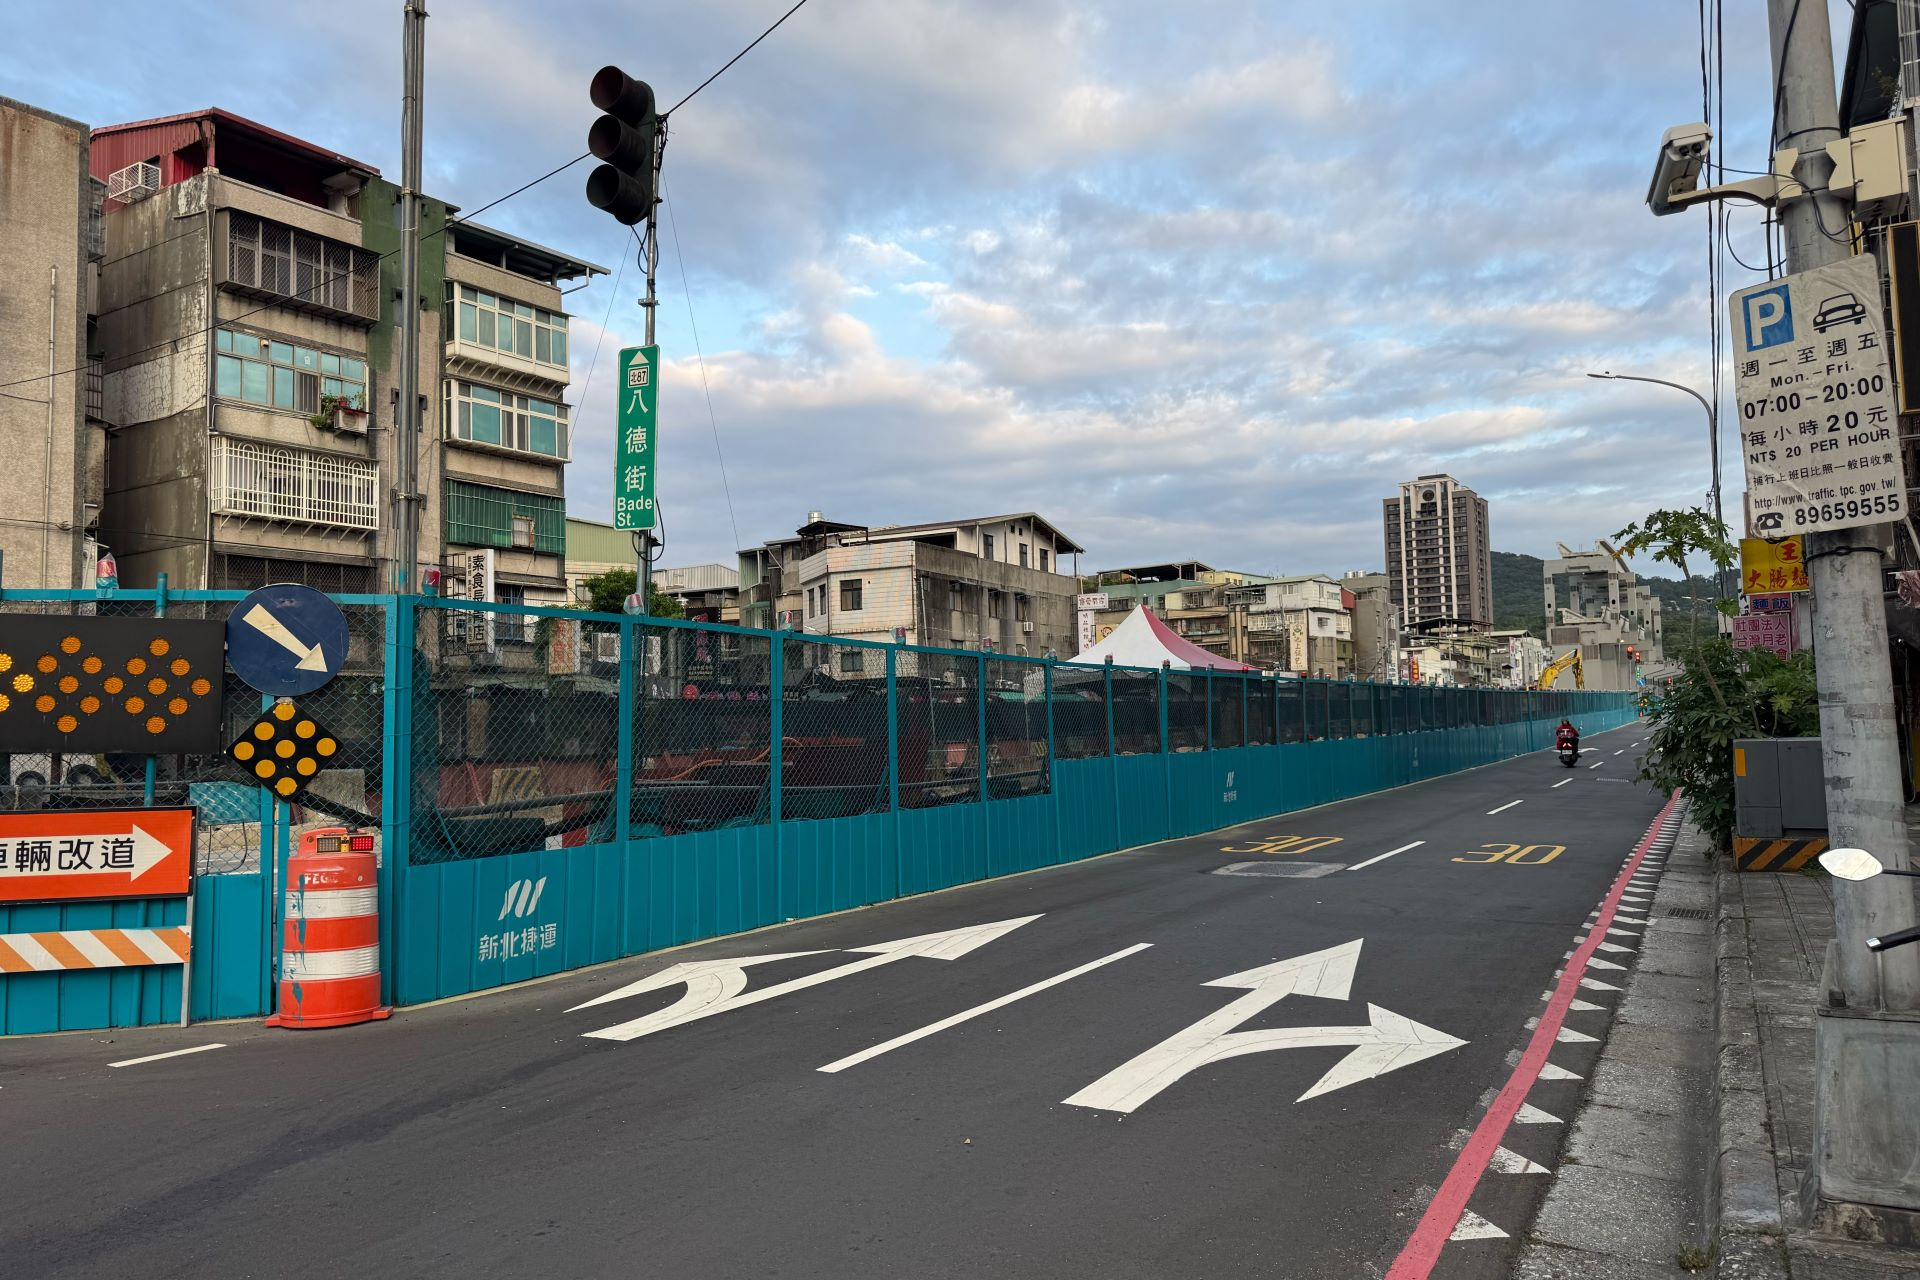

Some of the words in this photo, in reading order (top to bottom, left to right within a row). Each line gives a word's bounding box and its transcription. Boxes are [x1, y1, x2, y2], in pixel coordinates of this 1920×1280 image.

[1748, 294, 1785, 348] P
[1741, 332, 1879, 378] 週一至週五
[625, 389, 648, 492] 八德街
[1785, 446, 1801, 458] 20
[1810, 438, 1839, 453] PER
[1848, 428, 1890, 447] HOUR
[617, 496, 653, 512] Bade
[1795, 494, 1900, 526] 89659555
[617, 513, 636, 527] St.
[1781, 542, 1798, 560] 王
[1735, 618, 1786, 633] 社團法人
[1737, 633, 1787, 647] 台灣月老
[0, 837, 135, 872] 輛改道
[1220, 835, 1344, 854] 30
[1451, 843, 1567, 865] 30
[479, 922, 557, 962] 新北捷運
